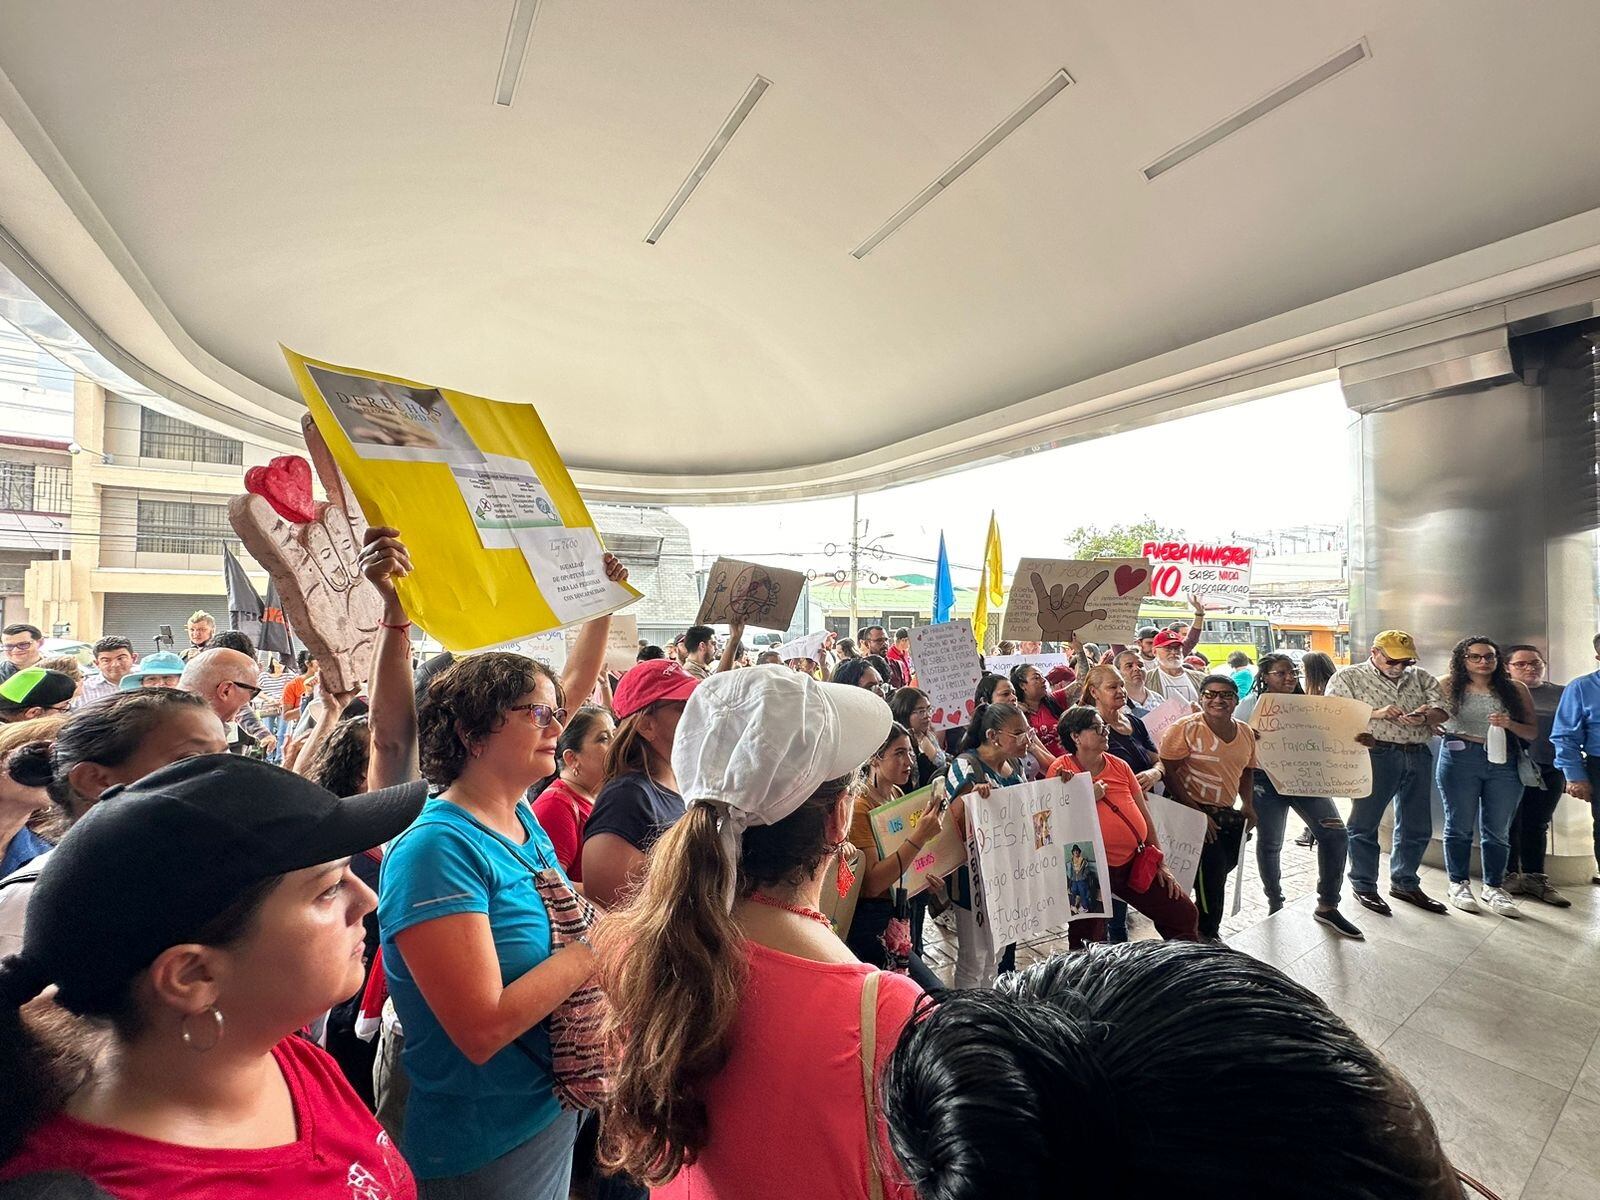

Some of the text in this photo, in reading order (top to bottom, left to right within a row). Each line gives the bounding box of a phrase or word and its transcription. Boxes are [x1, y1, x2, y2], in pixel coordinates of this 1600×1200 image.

[336, 391, 441, 417] DERECHOS
[1143, 542, 1252, 567] FUERA MINISTRA
[560, 561, 584, 571] IGUALDAD
[1188, 570, 1217, 580] SABE
[1219, 570, 1239, 580] NADA
[1181, 583, 1250, 594] DE DISCAPACIDAD
[1059, 788, 1070, 808] de
